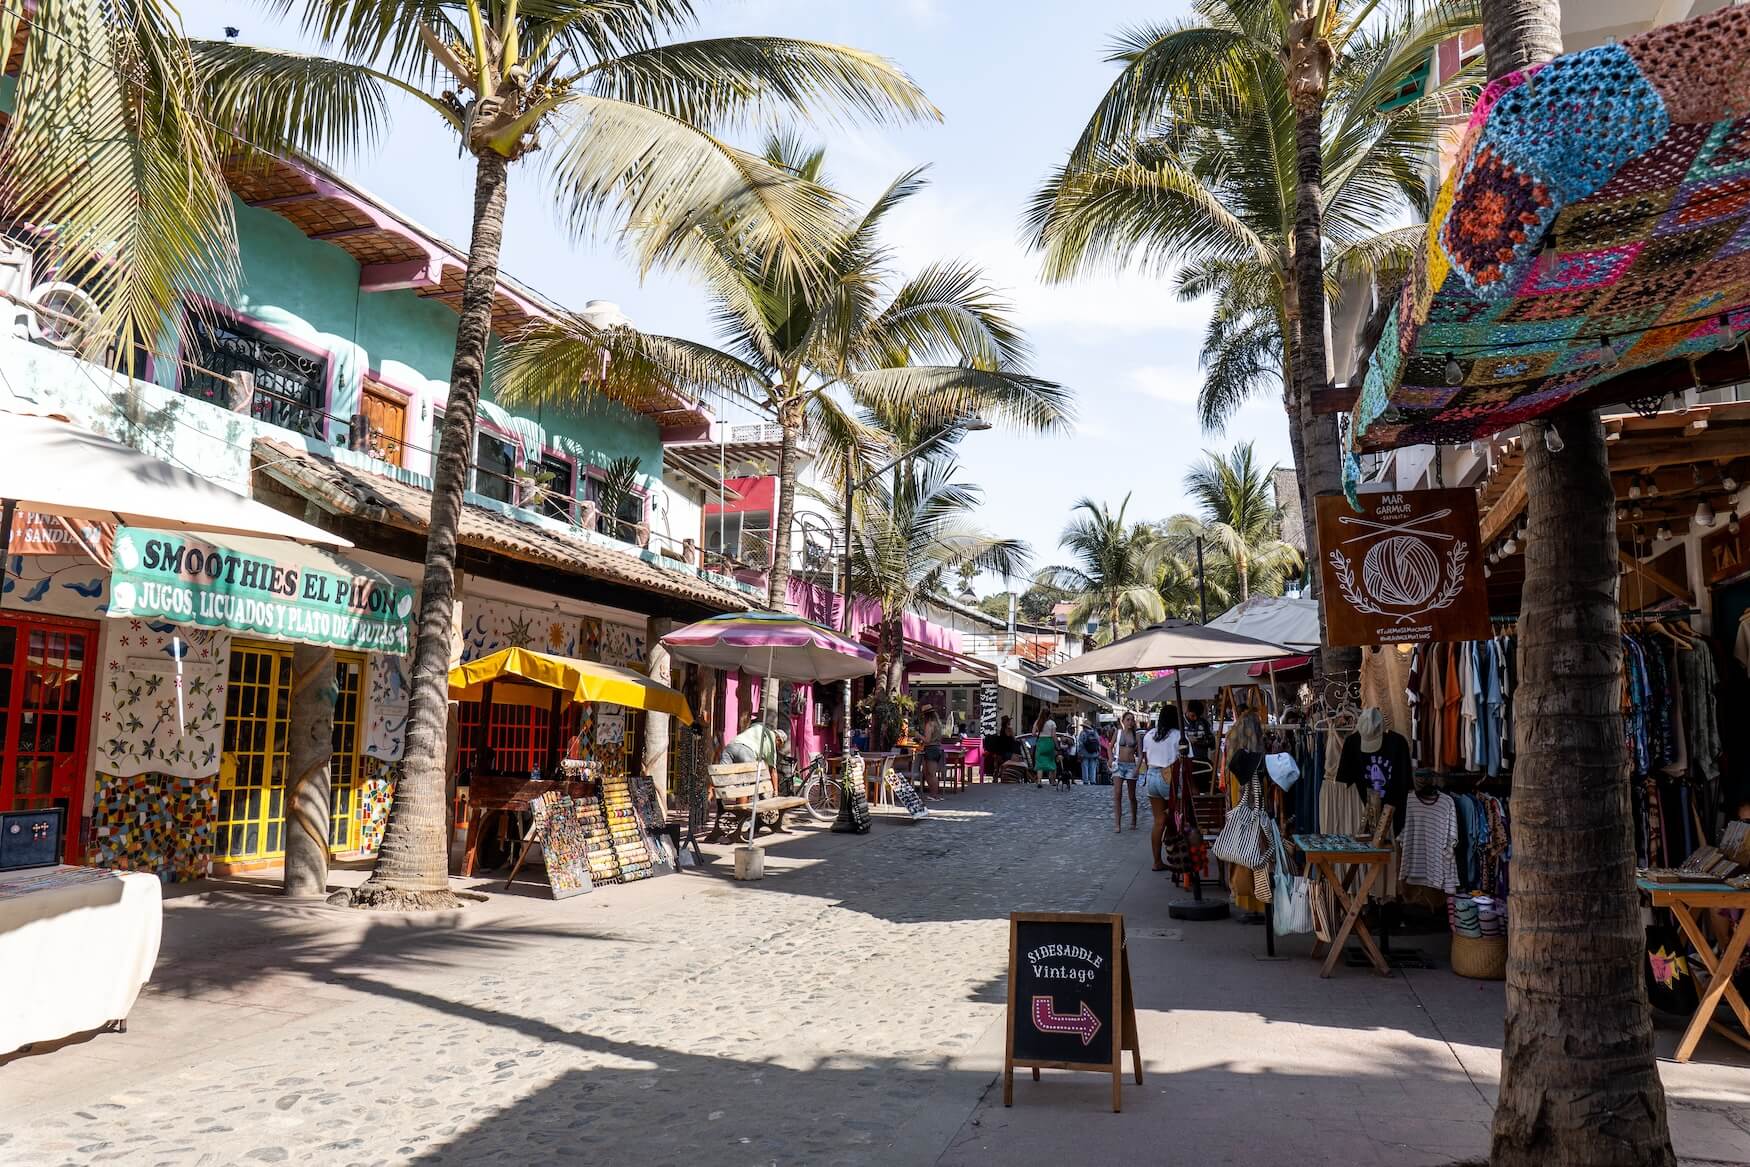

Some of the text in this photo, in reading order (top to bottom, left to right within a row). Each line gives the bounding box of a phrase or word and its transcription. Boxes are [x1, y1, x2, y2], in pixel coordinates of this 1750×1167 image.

[1375, 503, 1412, 515] GARMUR
[1381, 494, 1404, 505] MAR
[143, 539, 397, 615] SMOOTHIES EL PILON
[200, 590, 274, 628] LICUADOS
[274, 605, 287, 629] Y
[288, 607, 330, 636] PLATO
[332, 613, 350, 640] DE
[1027, 943, 1103, 969] SIDESADDLE
[1032, 964, 1096, 983] Vintage
